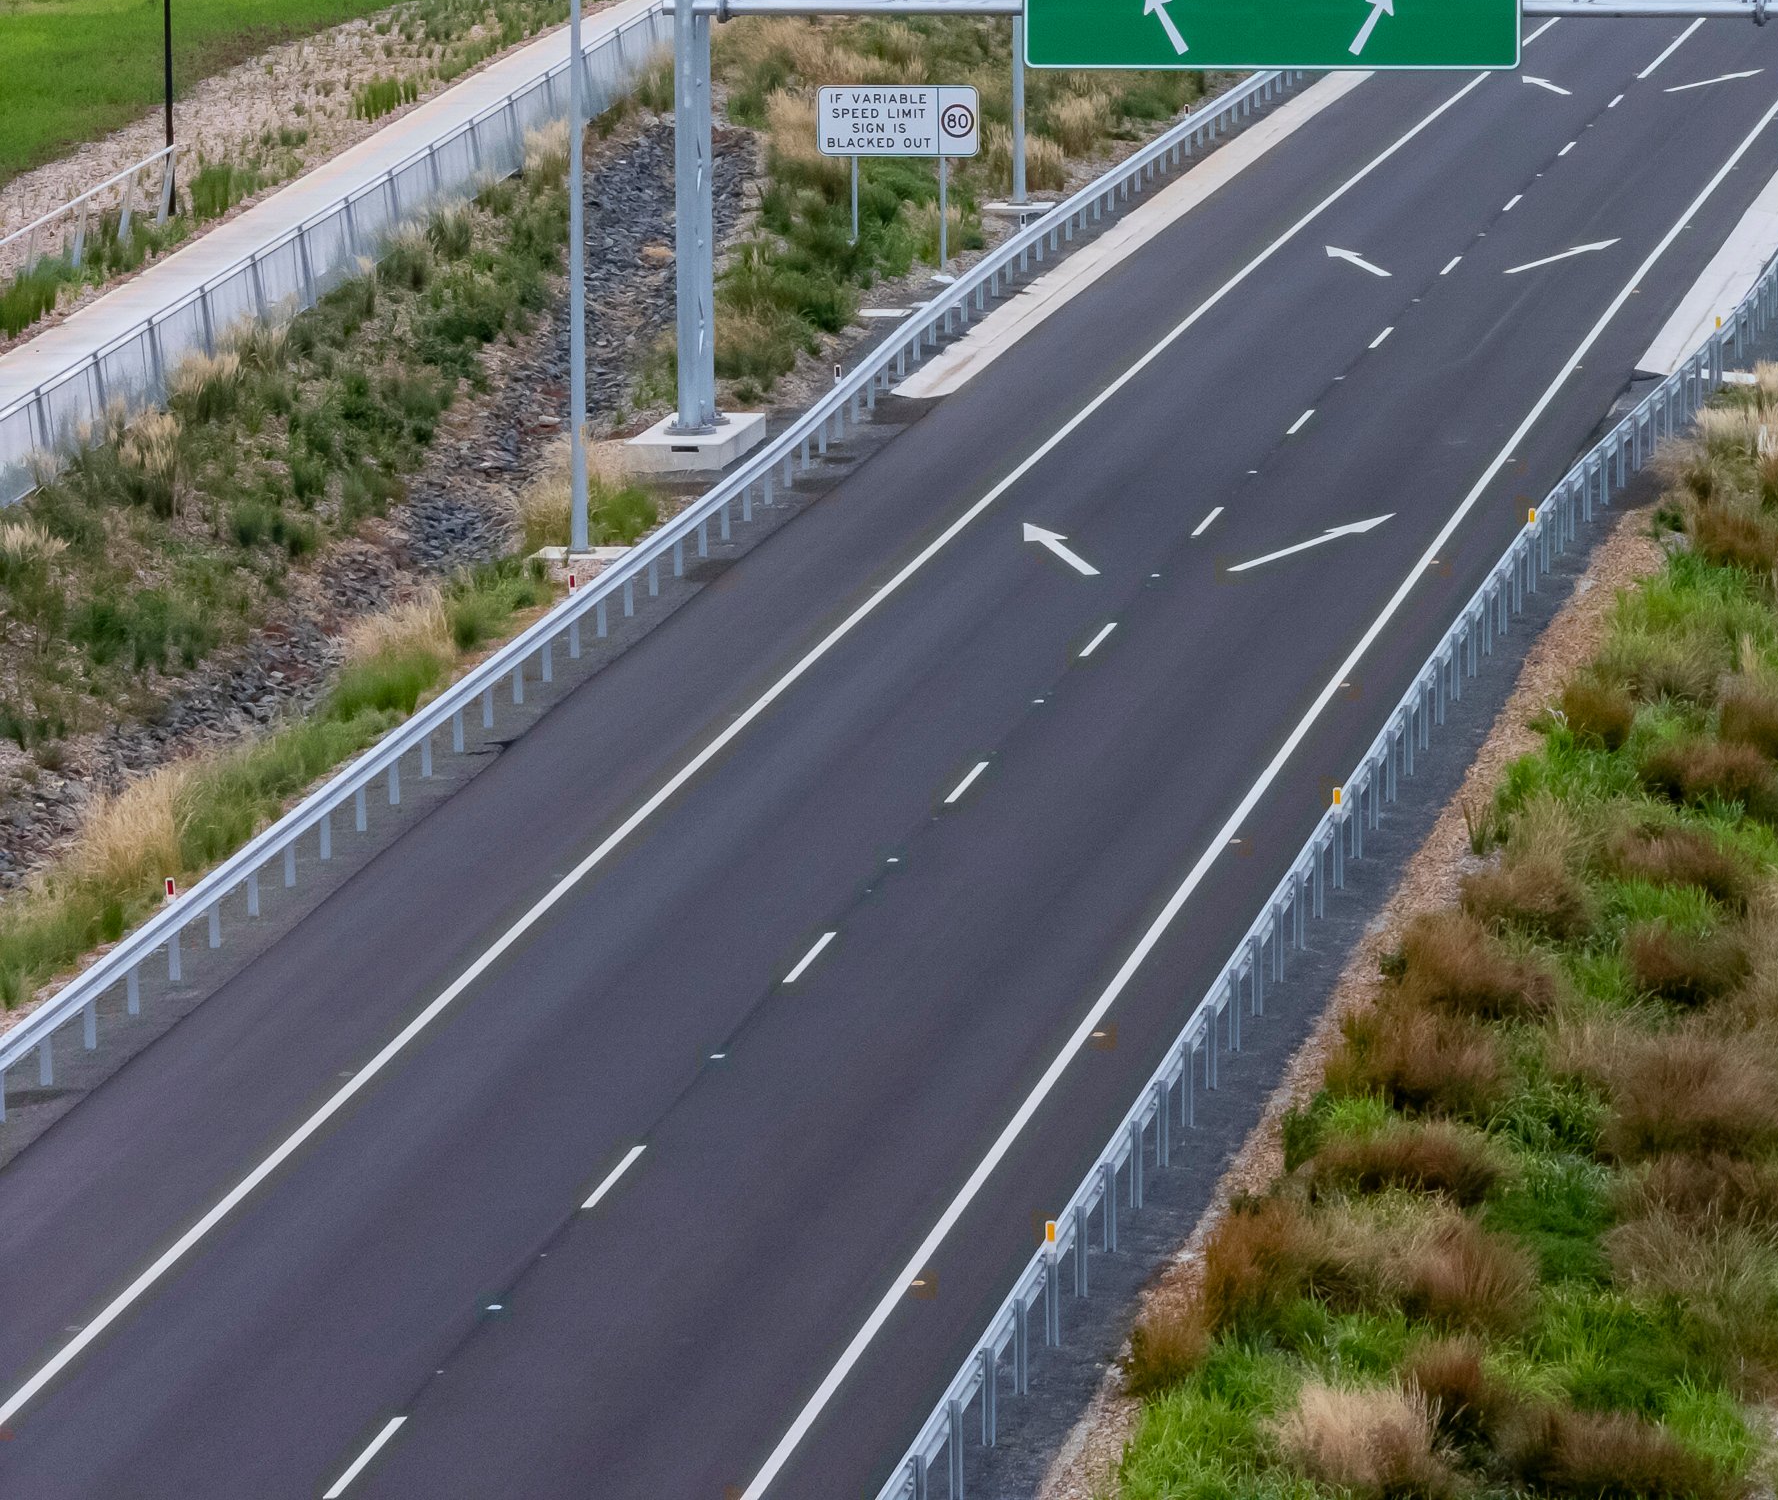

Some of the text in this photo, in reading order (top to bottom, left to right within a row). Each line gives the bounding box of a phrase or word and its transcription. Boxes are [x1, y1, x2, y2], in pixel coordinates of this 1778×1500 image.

[830, 93, 927, 104] IF VARIABLE
[832, 108, 926, 119] SPEED LIMIT
[947, 113, 969, 129] 80
[852, 123, 907, 134] SIGN IS
[827, 137, 931, 149] BLACKED OUT
